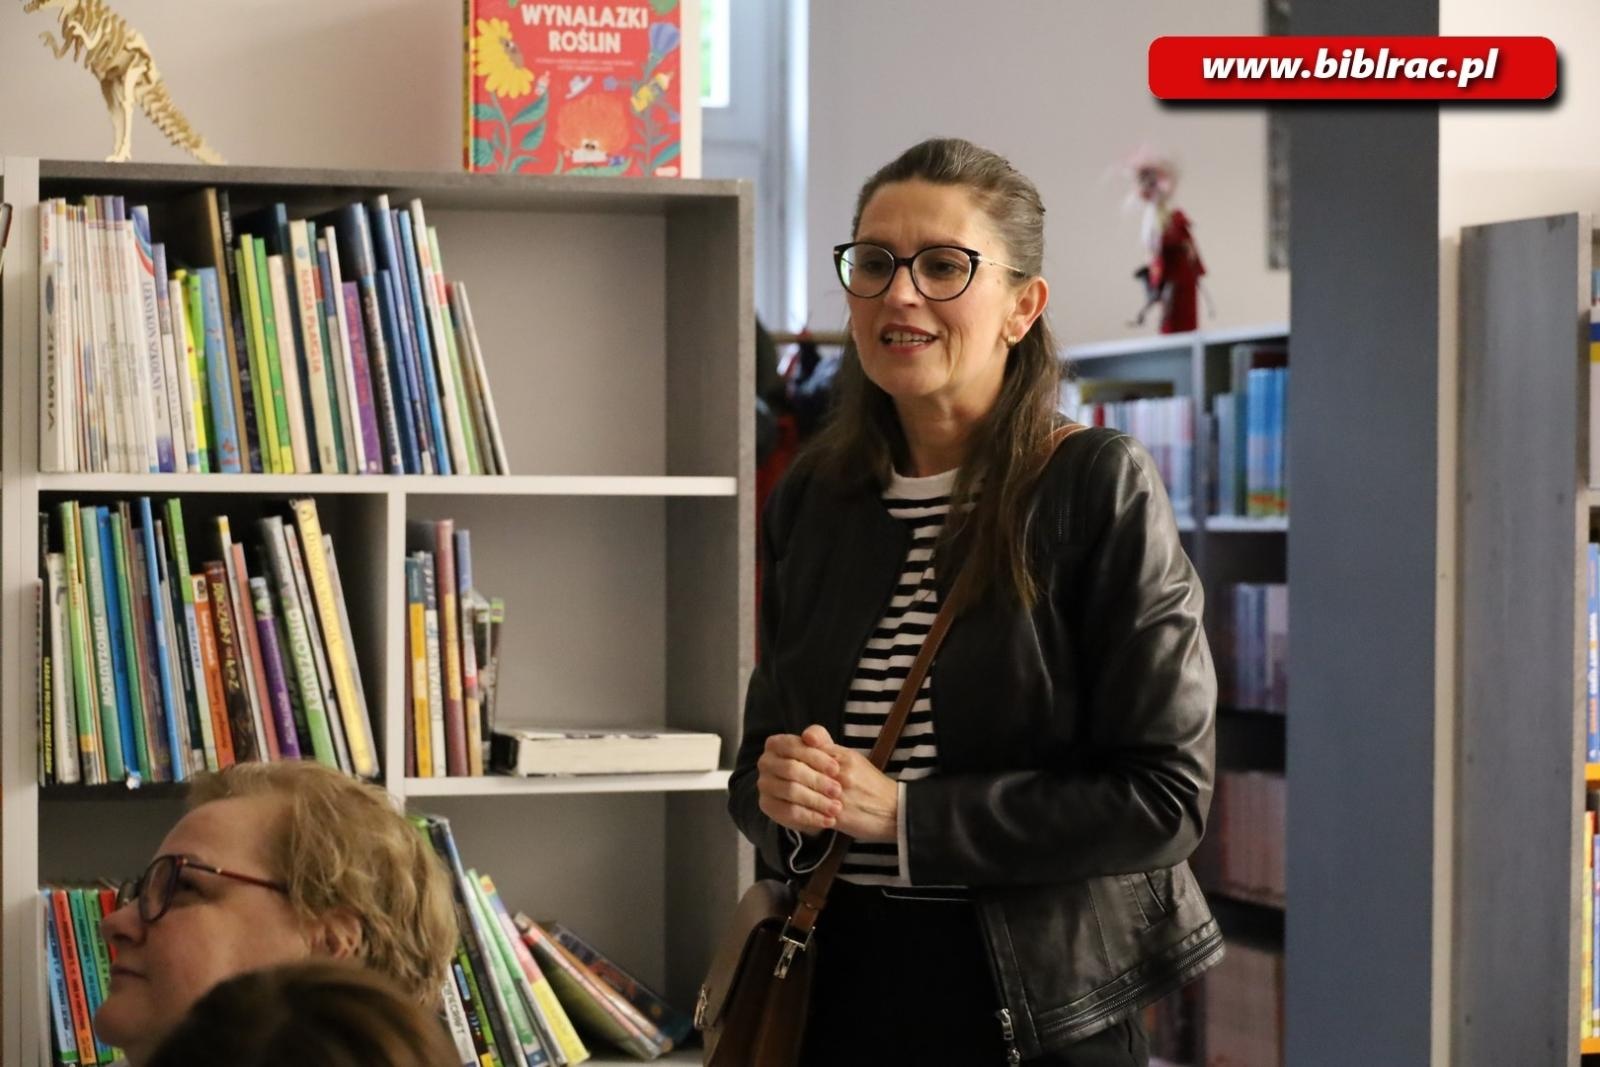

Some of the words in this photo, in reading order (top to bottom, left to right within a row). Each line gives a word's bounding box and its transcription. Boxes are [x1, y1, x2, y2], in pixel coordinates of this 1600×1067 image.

[521, 4, 648, 29] WYNALAZKI
[549, 26, 621, 53] ROŚLIN
[142, 281, 155, 337] LEKSYKON
[300, 269, 315, 312] NASZA
[147, 341, 161, 391] SZKOLNY
[305, 314, 321, 374] PLANETA
[47, 325, 55, 432] ZIEMIA
[212, 581, 231, 643] DINOZAURY
[94, 616, 114, 707] DINOZAURÓW
[285, 608, 321, 711] DINOZAURY
